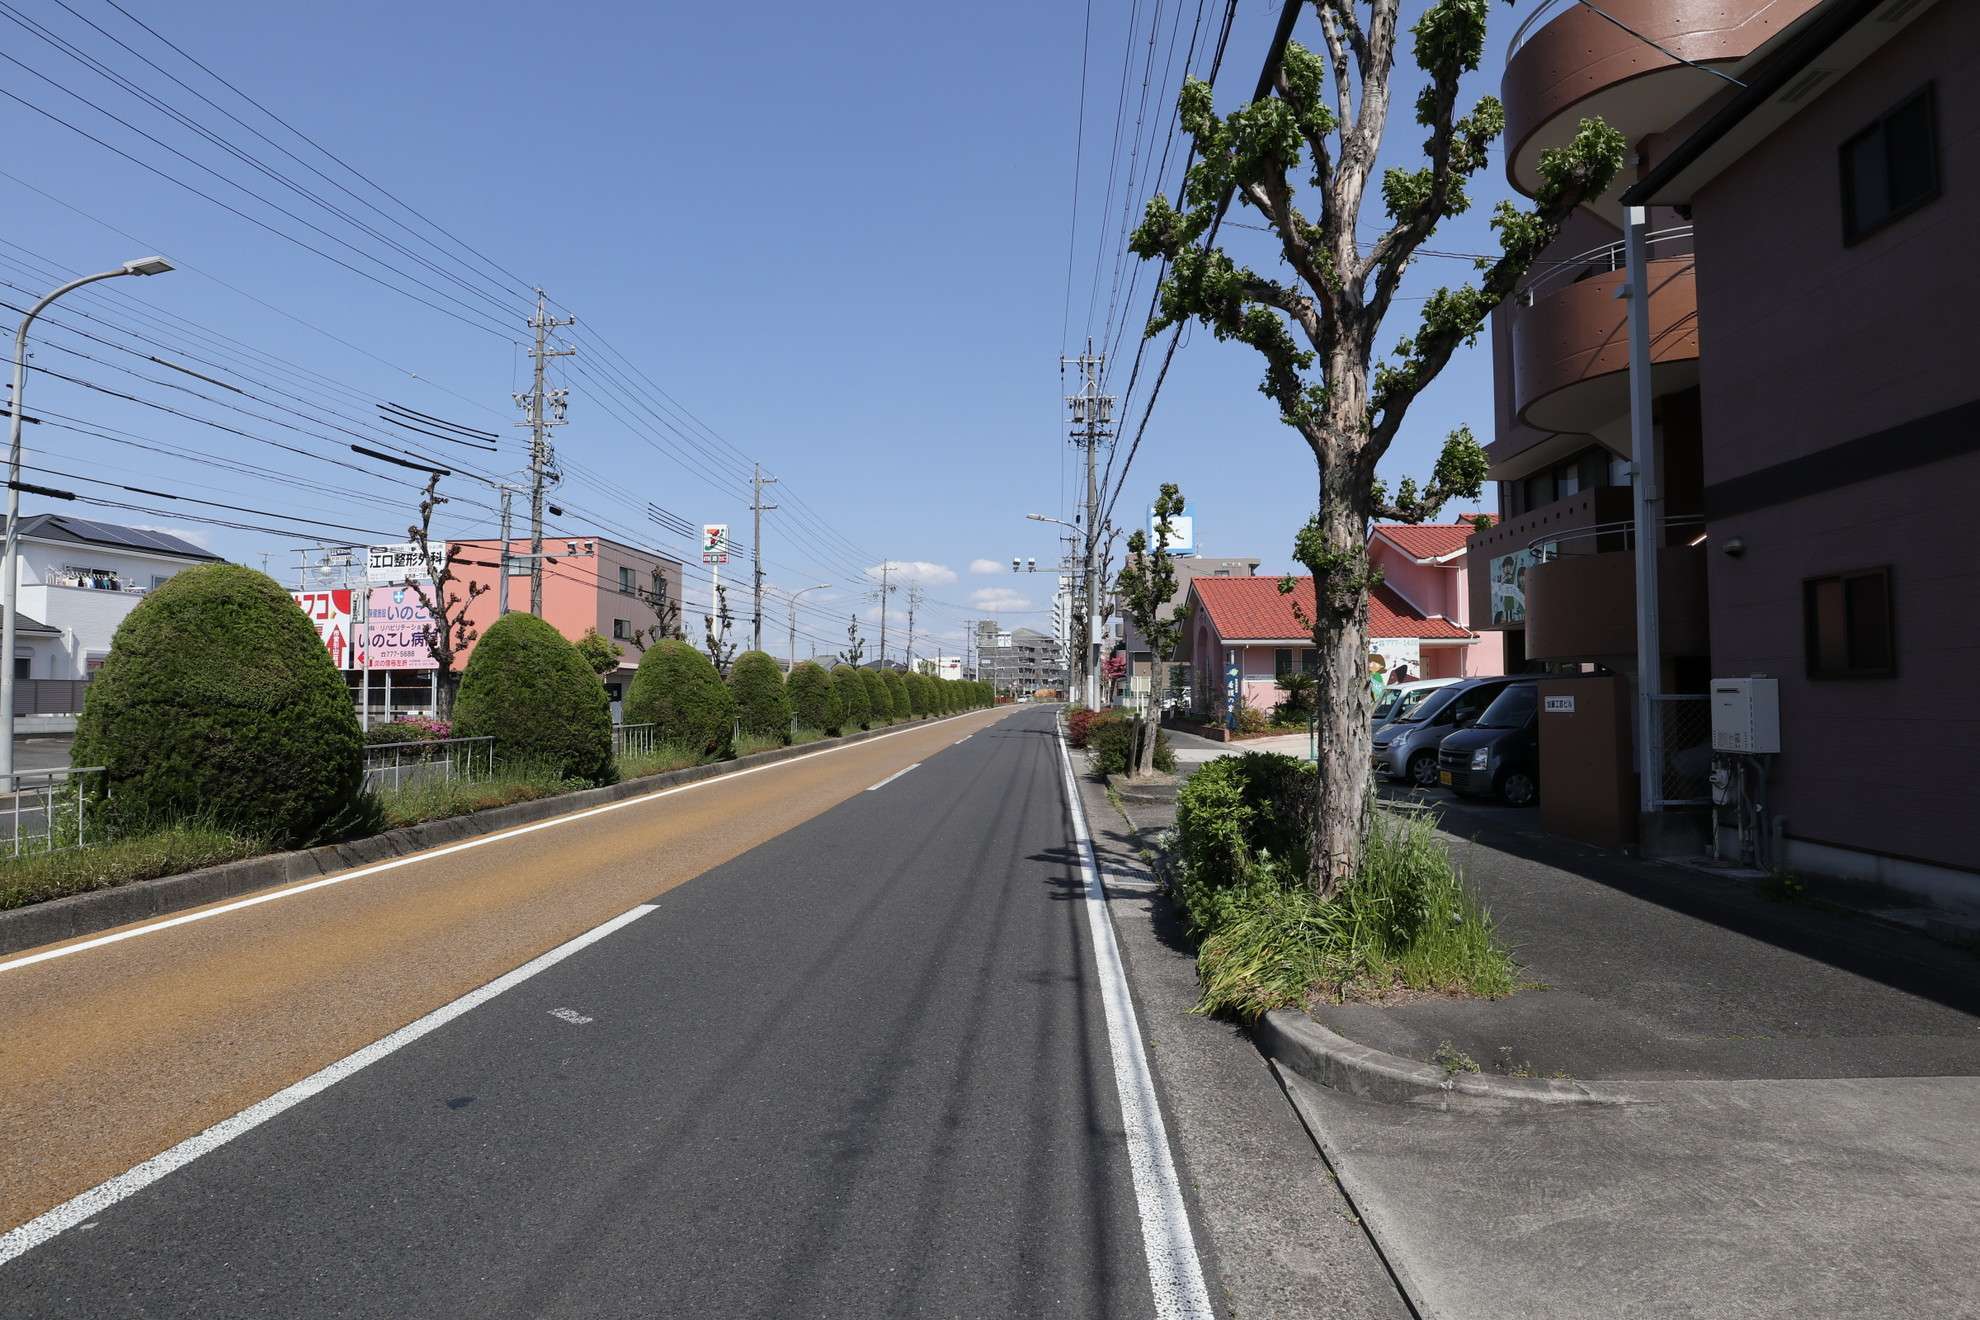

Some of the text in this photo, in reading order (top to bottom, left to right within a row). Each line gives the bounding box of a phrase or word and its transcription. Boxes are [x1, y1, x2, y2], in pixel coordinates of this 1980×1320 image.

[387, 605, 437, 620] いのこ
[358, 632, 438, 648] いのこし病
